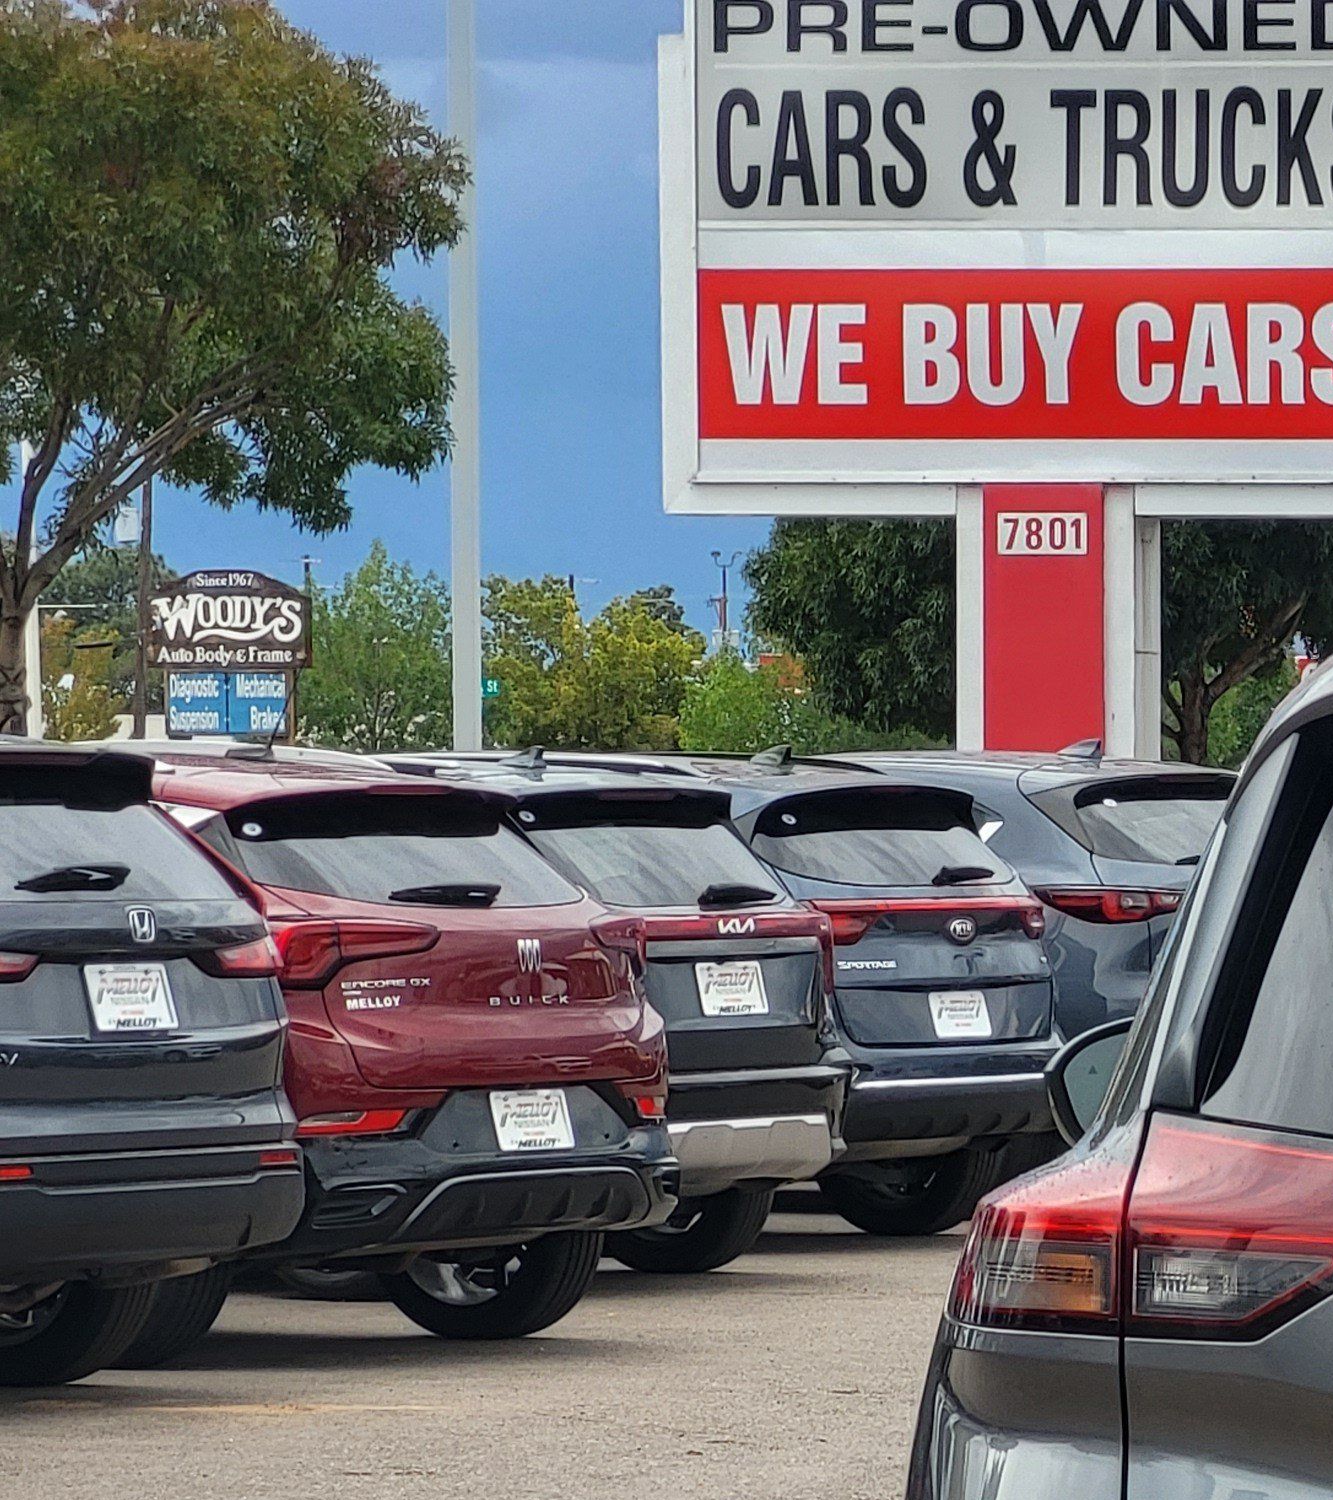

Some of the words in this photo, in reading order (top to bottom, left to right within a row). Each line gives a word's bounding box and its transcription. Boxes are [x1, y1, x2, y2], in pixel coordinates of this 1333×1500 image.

[715, 86, 927, 209] CARS
[962, 89, 1018, 208] &
[721, 303, 868, 406] WE
[903, 302, 1084, 407] BUY
[1003, 518, 1087, 552] 7801
[196, 573, 227, 587] Since
[228, 573, 254, 587] 1967
[150, 593, 302, 643] WOODY'S
[157, 646, 194, 663] Auto
[194, 645, 234, 667] Body
[235, 647, 247, 663] &
[248, 646, 293, 662] Frame
[169, 674, 219, 703] Diagnostic
[236, 674, 286, 698] Mechanical
[169, 706, 219, 731] Suspension
[250, 705, 286, 730] Brakes
[340, 978, 406, 990] ENCORE
[410, 977, 432, 987] GX
[346, 995, 401, 1011] MELLOY
[489, 995, 570, 1006] BUICK
[116, 1017, 157, 1029] MELLOY
